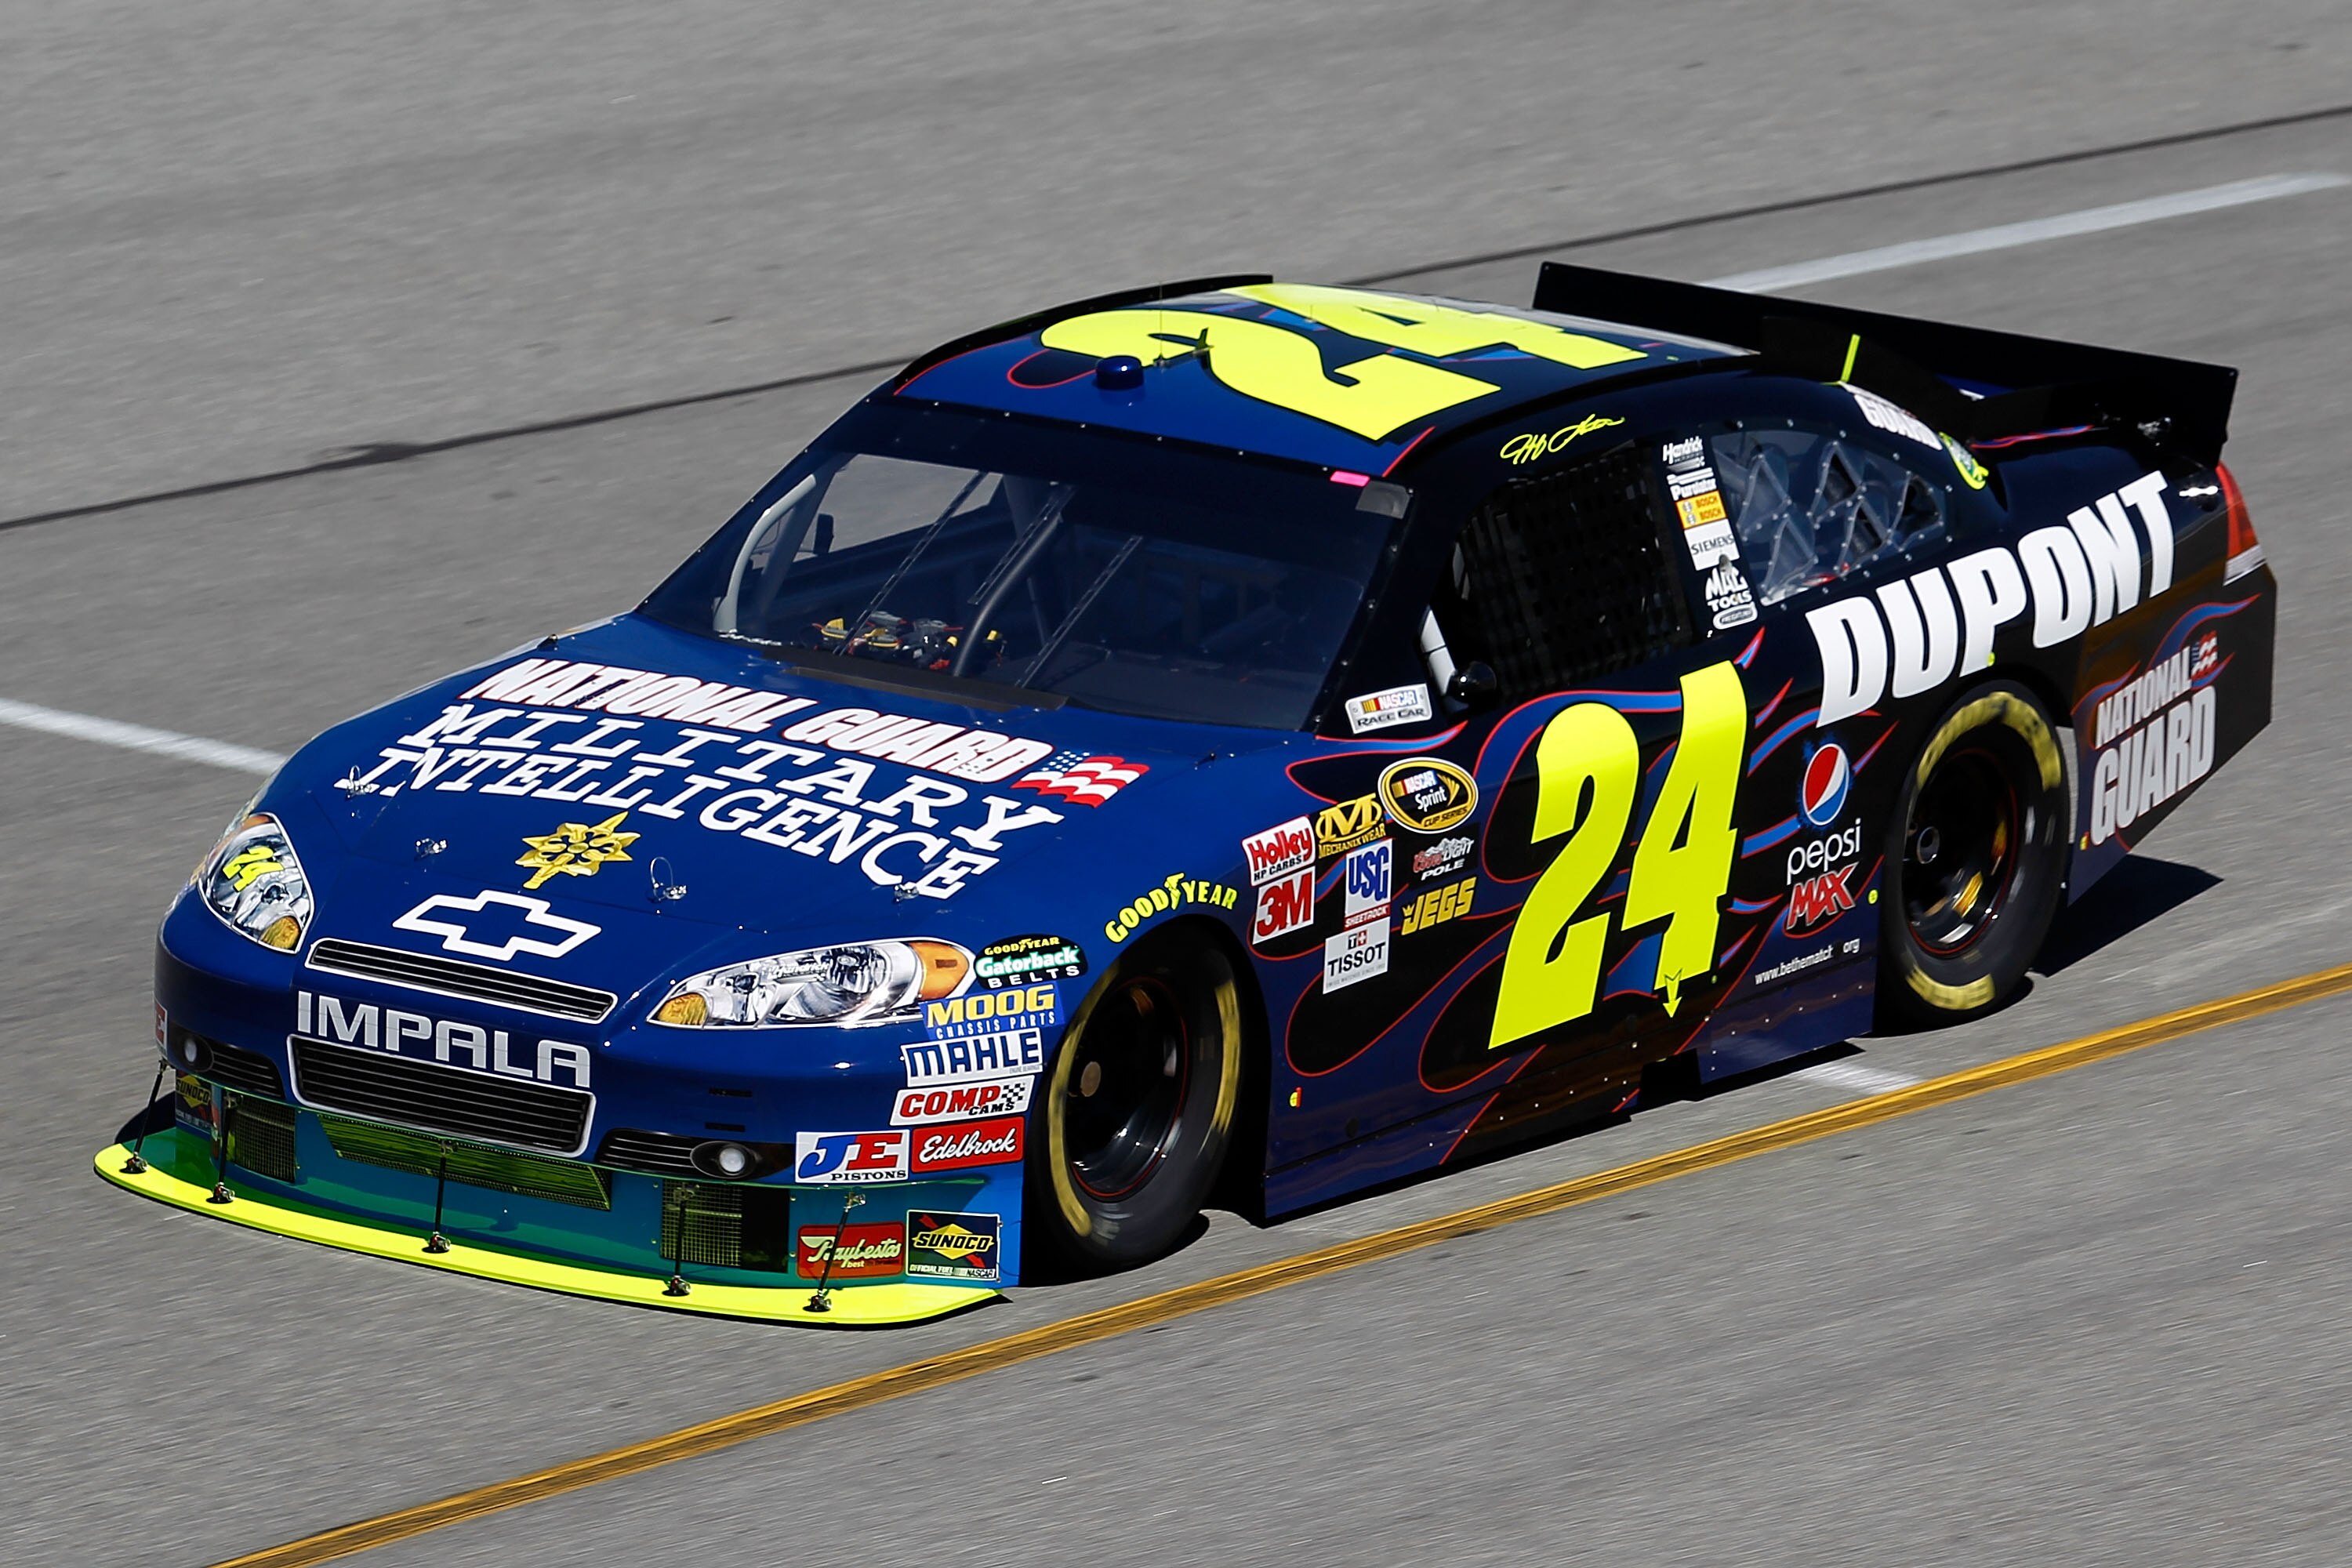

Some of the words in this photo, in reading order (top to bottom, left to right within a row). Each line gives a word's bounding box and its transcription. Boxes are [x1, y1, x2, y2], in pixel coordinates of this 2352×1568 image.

[1040, 284, 1650, 441] 24
[1691, 533, 1735, 556] SIEMENS
[1705, 566, 1748, 601] MAC
[1805, 470, 2175, 728] DUPONT
[1377, 690, 1417, 711] NASCAR
[2096, 646, 2192, 750] NATIONAL
[457, 658, 820, 734] NATIONAL
[782, 707, 1054, 784] GUARD
[1357, 711, 1396, 727] RACE
[1398, 708, 1425, 718] CAR
[397, 704, 1065, 852] MILITARY
[1404, 770, 1437, 794] NASCAR
[2090, 685, 2216, 846] GUARD
[1414, 786, 1447, 812] Sprint
[334, 747, 1000, 900] INTELLIGENCE
[1423, 817, 1440, 828] CUP
[1441, 806, 1468, 821] SERIES
[1247, 828, 1312, 872] Holley
[1318, 838, 1362, 859] MECHANIX
[1362, 822, 1387, 844] WEAR
[1488, 660, 1748, 1050] 24
[1786, 818, 1861, 885] pepsi
[223, 846, 285, 892] 24
[1254, 869, 1268, 882] HP
[1269, 855, 1302, 876] CARBS
[1348, 846, 1389, 901] USG
[1421, 858, 1465, 881] POLE
[1105, 873, 1238, 943] GOODYEAR
[1257, 871, 1312, 937] 3M
[1401, 877, 1477, 936] JEGS
[1786, 862, 1860, 931] MAX
[976, 946, 1080, 978] Gatorback
[984, 936, 1060, 956] GOODYEAR
[1327, 942, 1386, 977] TISSOT
[988, 965, 1080, 989] BELTS
[927, 985, 1055, 1028] MOOG
[297, 991, 590, 1088] IMPALA
[936, 1018, 1000, 1040] CHASSIS
[1010, 1011, 1056, 1029] PARTS
[905, 1032, 1040, 1077] MAHLE
[176, 1078, 210, 1102] SUNOCO
[899, 1085, 1000, 1118] COMP
[968, 1101, 1014, 1116] CAMS
[798, 1133, 903, 1178] JE
[918, 1128, 1016, 1163] Edelbrock
[831, 1171, 907, 1181] PISTONS
[916, 1233, 990, 1250] SUNOCO
[909, 1264, 937, 1272] OFFICIAL
[937, 1265, 953, 1274] FUEL
[966, 1268, 993, 1279] NASCAR
